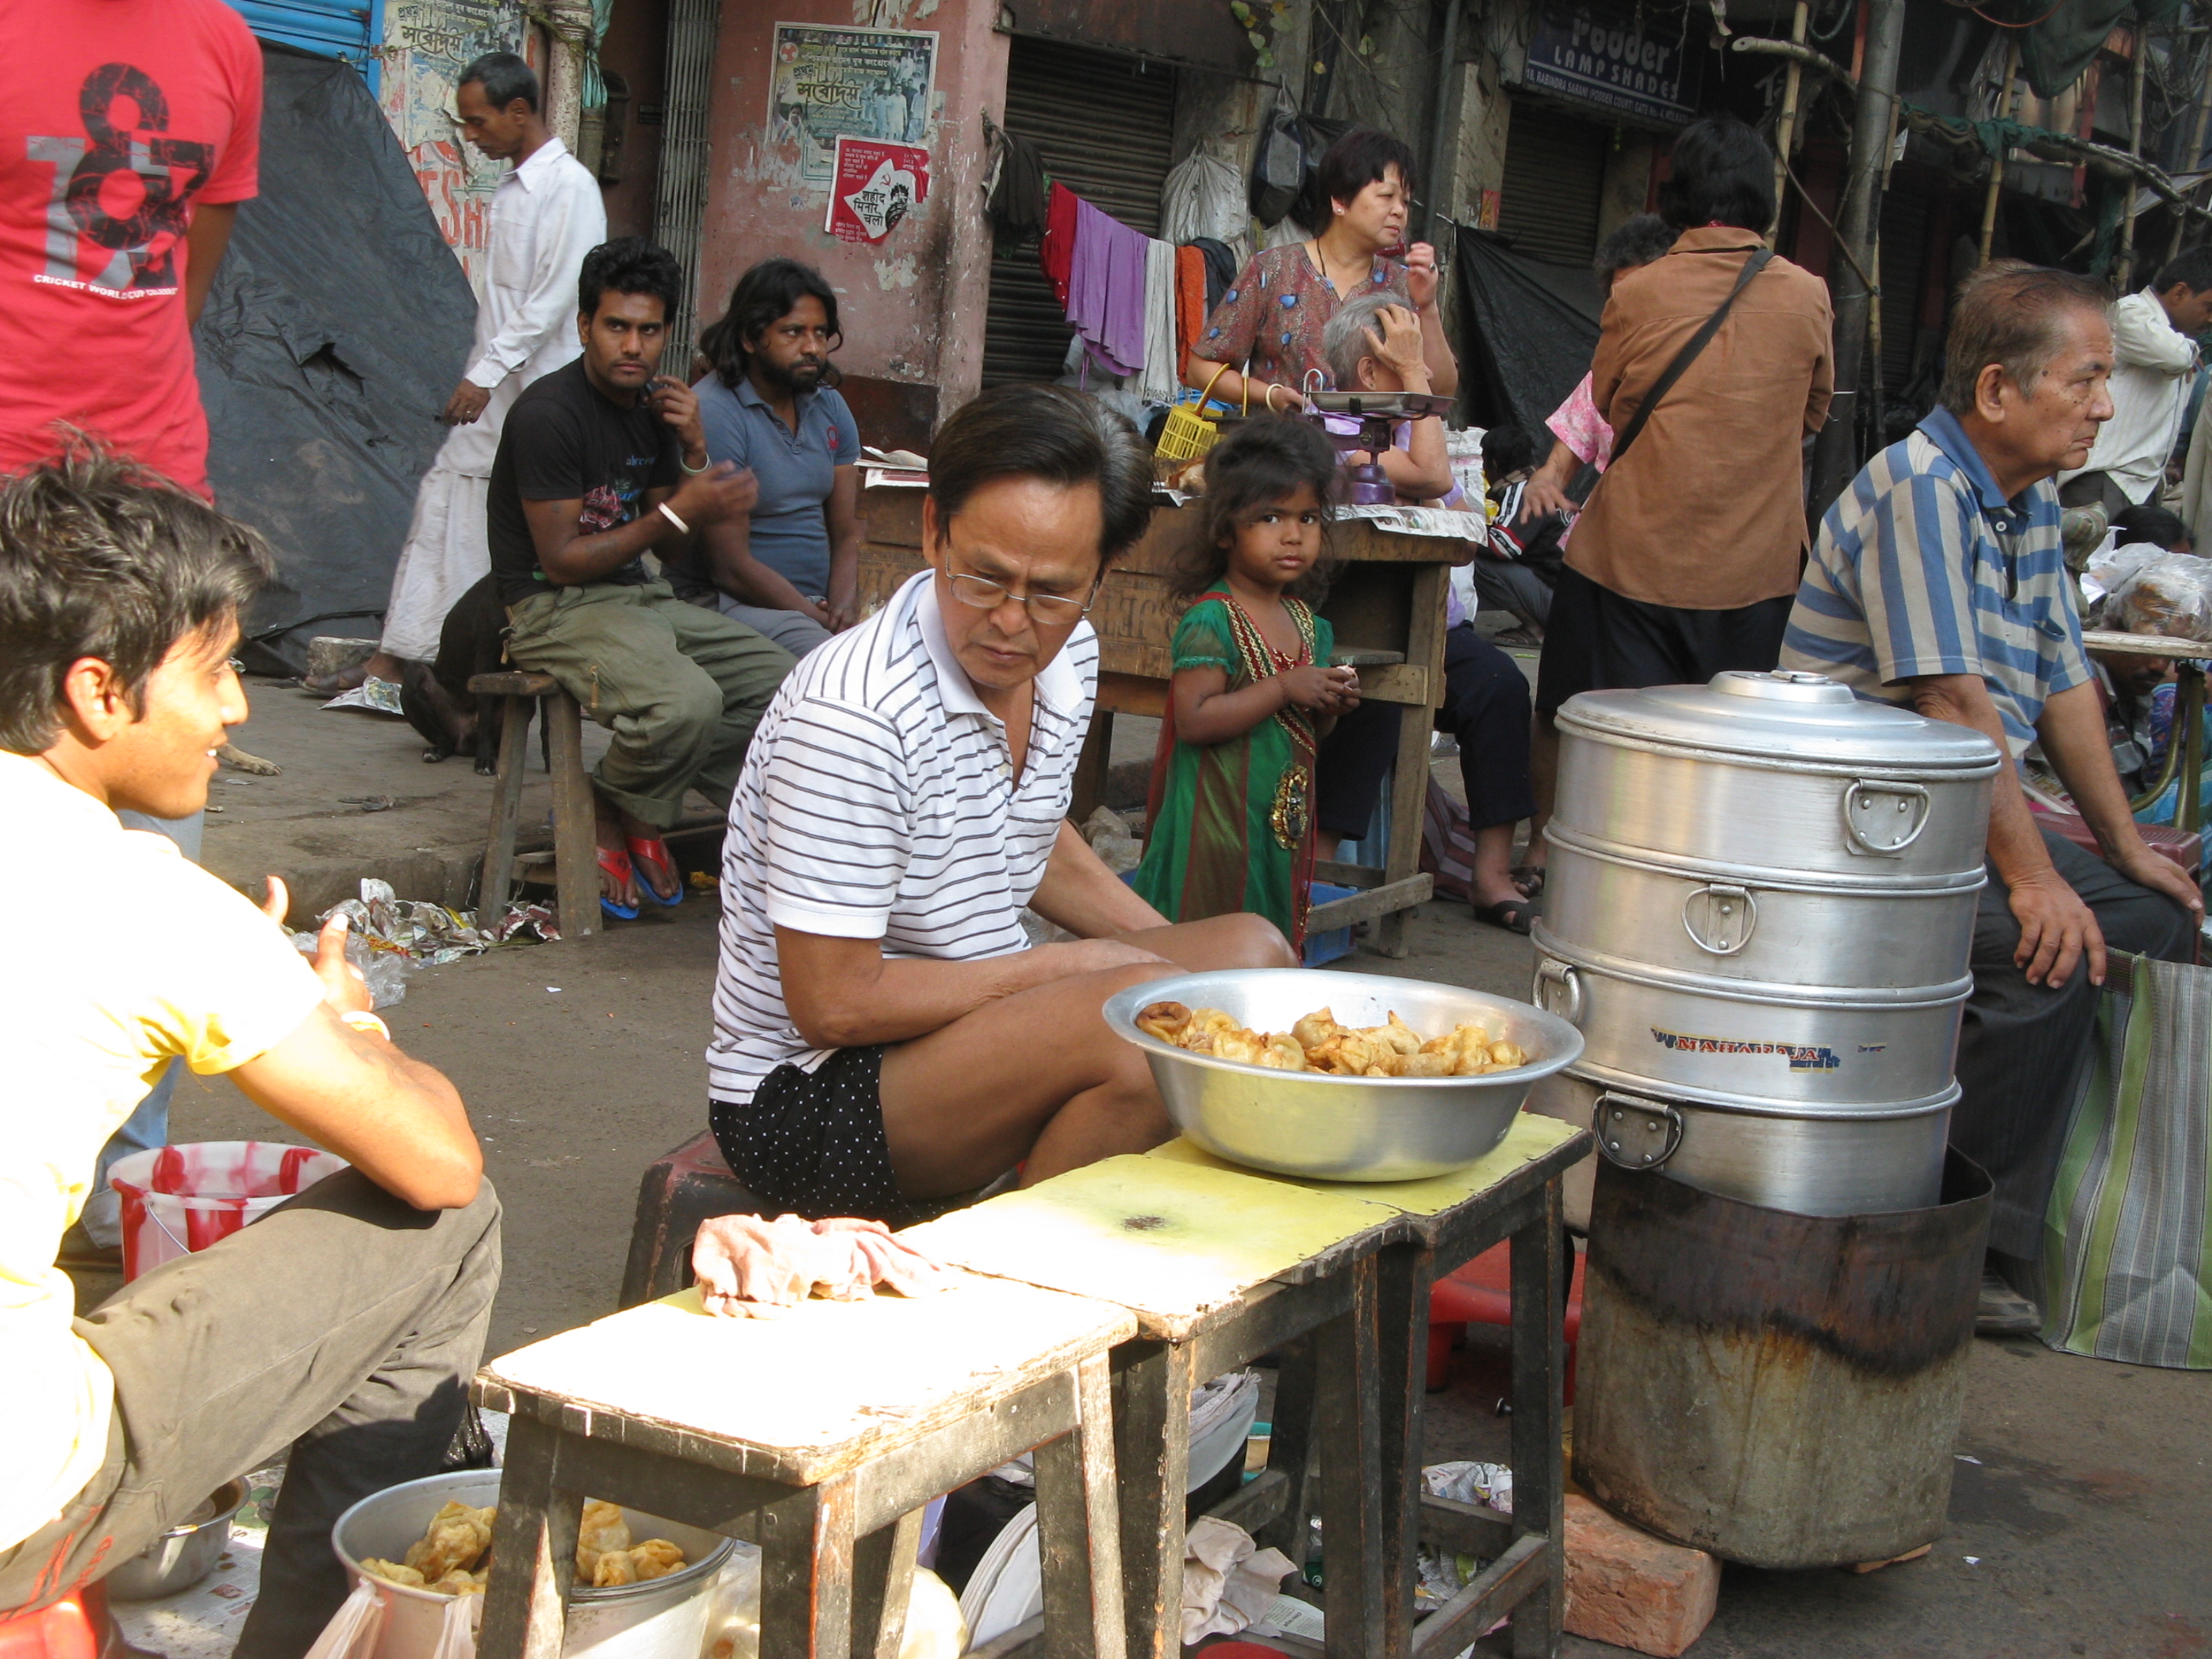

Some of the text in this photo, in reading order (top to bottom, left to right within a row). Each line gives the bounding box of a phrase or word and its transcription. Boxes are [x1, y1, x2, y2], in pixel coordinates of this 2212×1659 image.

[1554, 45, 1679, 102] LAMP SHADES
[862, 189, 886, 205] शहीद
[863, 213, 884, 227] चलो
[33, 274, 86, 289] CRICKET
[89, 284, 128, 300] WORLD
[128, 289, 146, 299] CUP
